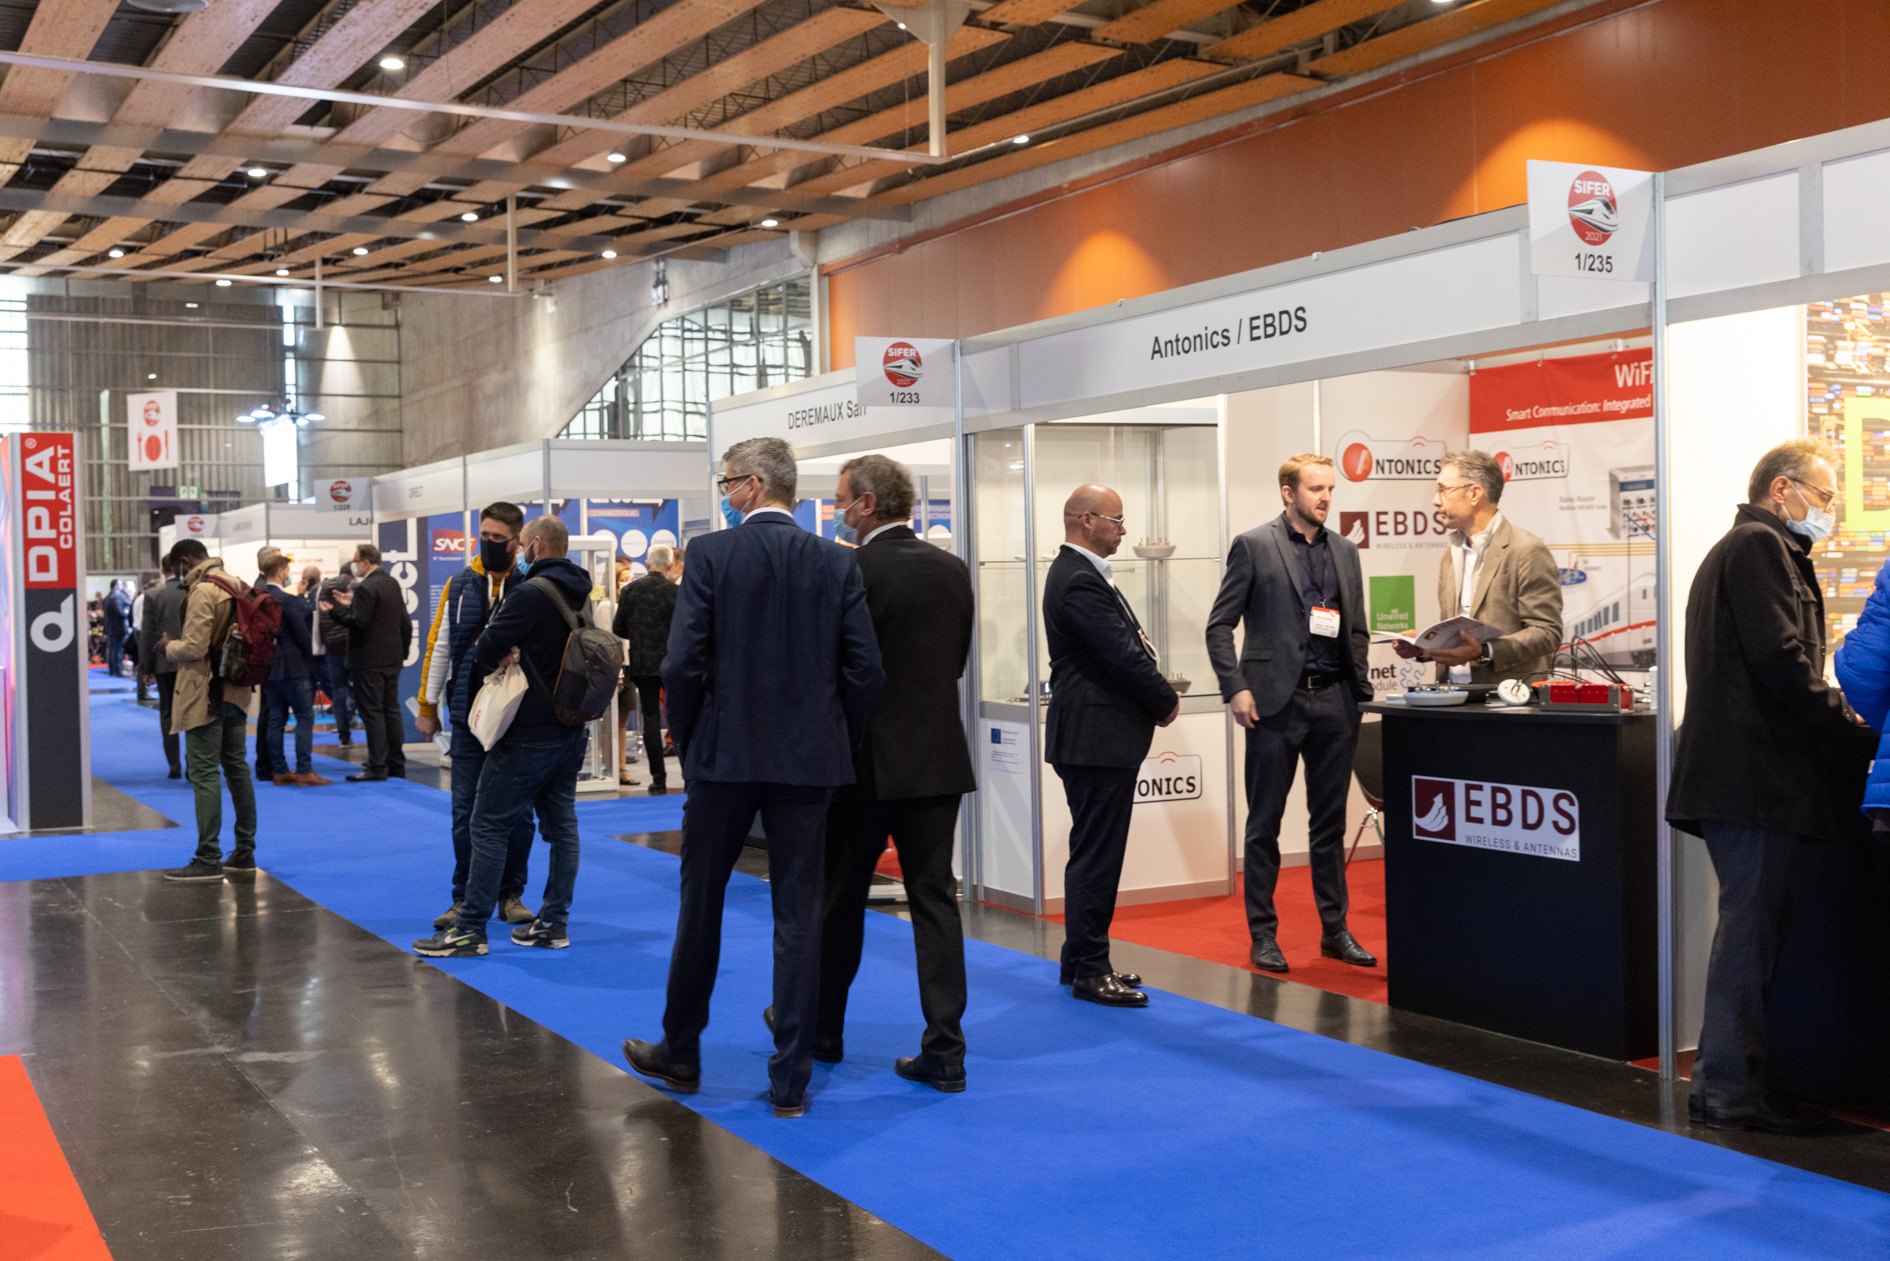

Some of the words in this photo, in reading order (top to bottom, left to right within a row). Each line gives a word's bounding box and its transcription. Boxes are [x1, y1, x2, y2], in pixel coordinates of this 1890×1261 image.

[1574, 180, 1611, 196] SIFER
[1585, 231, 1602, 241] 2021
[1575, 252, 1613, 273] 1/235
[1150, 326, 1231, 360] Antonics
[1249, 306, 1307, 341] EBDS
[887, 347, 917, 357] SIFER
[889, 392, 920, 404] 1/233
[1506, 408, 1532, 421] Smart
[1532, 401, 1601, 419] Communication:
[1602, 394, 1652, 413] Integrated
[788, 402, 844, 430] DEREMAUX
[57, 445, 73, 549] COLAERT
[1376, 511, 1447, 536] EBDS
[1136, 775, 1196, 797] ONICS
[1464, 782, 1576, 836] EBDS
[1465, 834, 1511, 851] WIRELESS
[1513, 841, 1520, 850] &
[1523, 842, 1578, 860] ANTENNAS
